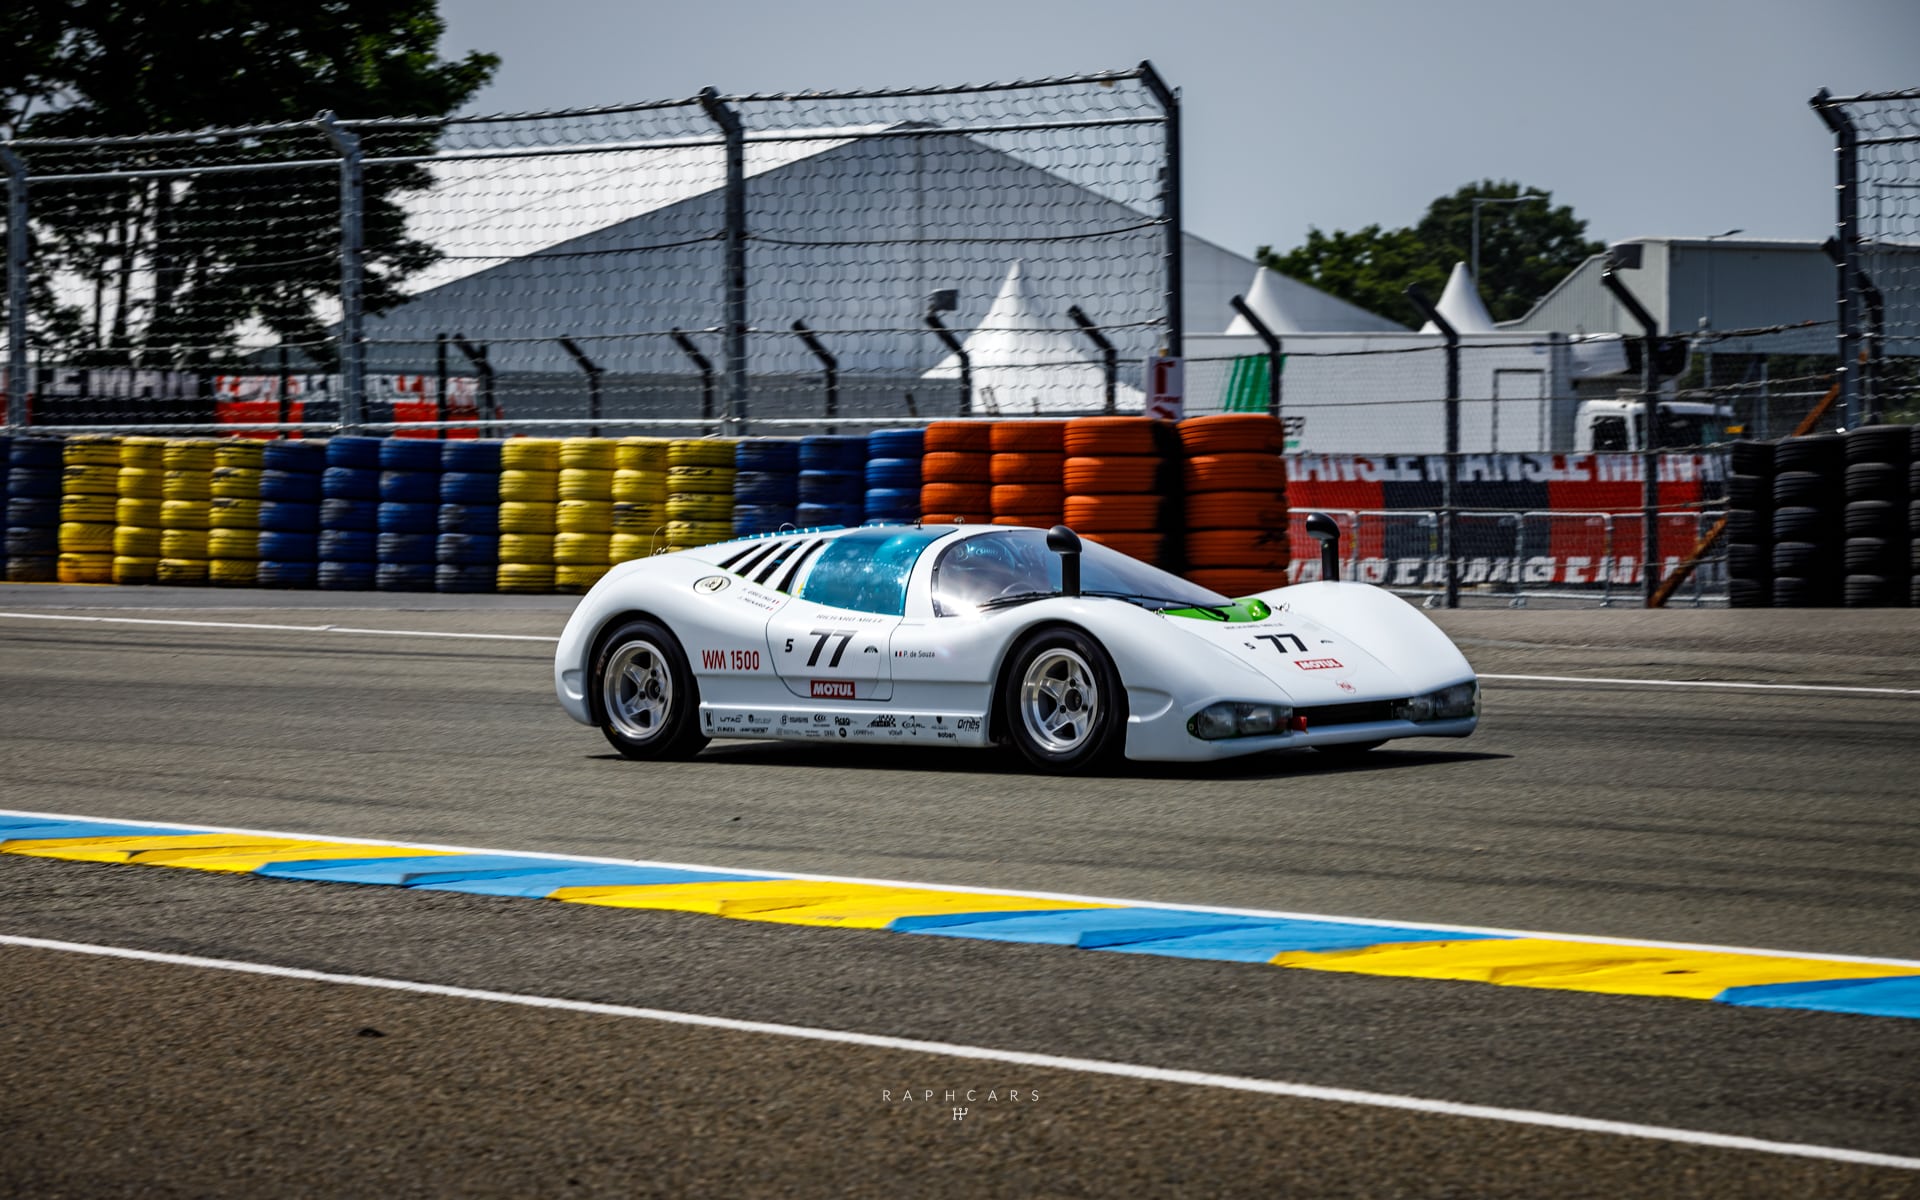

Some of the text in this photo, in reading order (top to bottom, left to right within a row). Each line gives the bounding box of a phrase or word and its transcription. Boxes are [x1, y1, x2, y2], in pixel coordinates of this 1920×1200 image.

[784, 638, 795, 653] 5
[806, 628, 858, 668] 77
[1253, 633, 1309, 654] 77
[702, 649, 760, 671] WM 1500
[910, 650, 917, 658] de
[1301, 660, 1341, 670] MOTUL
[812, 682, 854, 696] MOTUL
